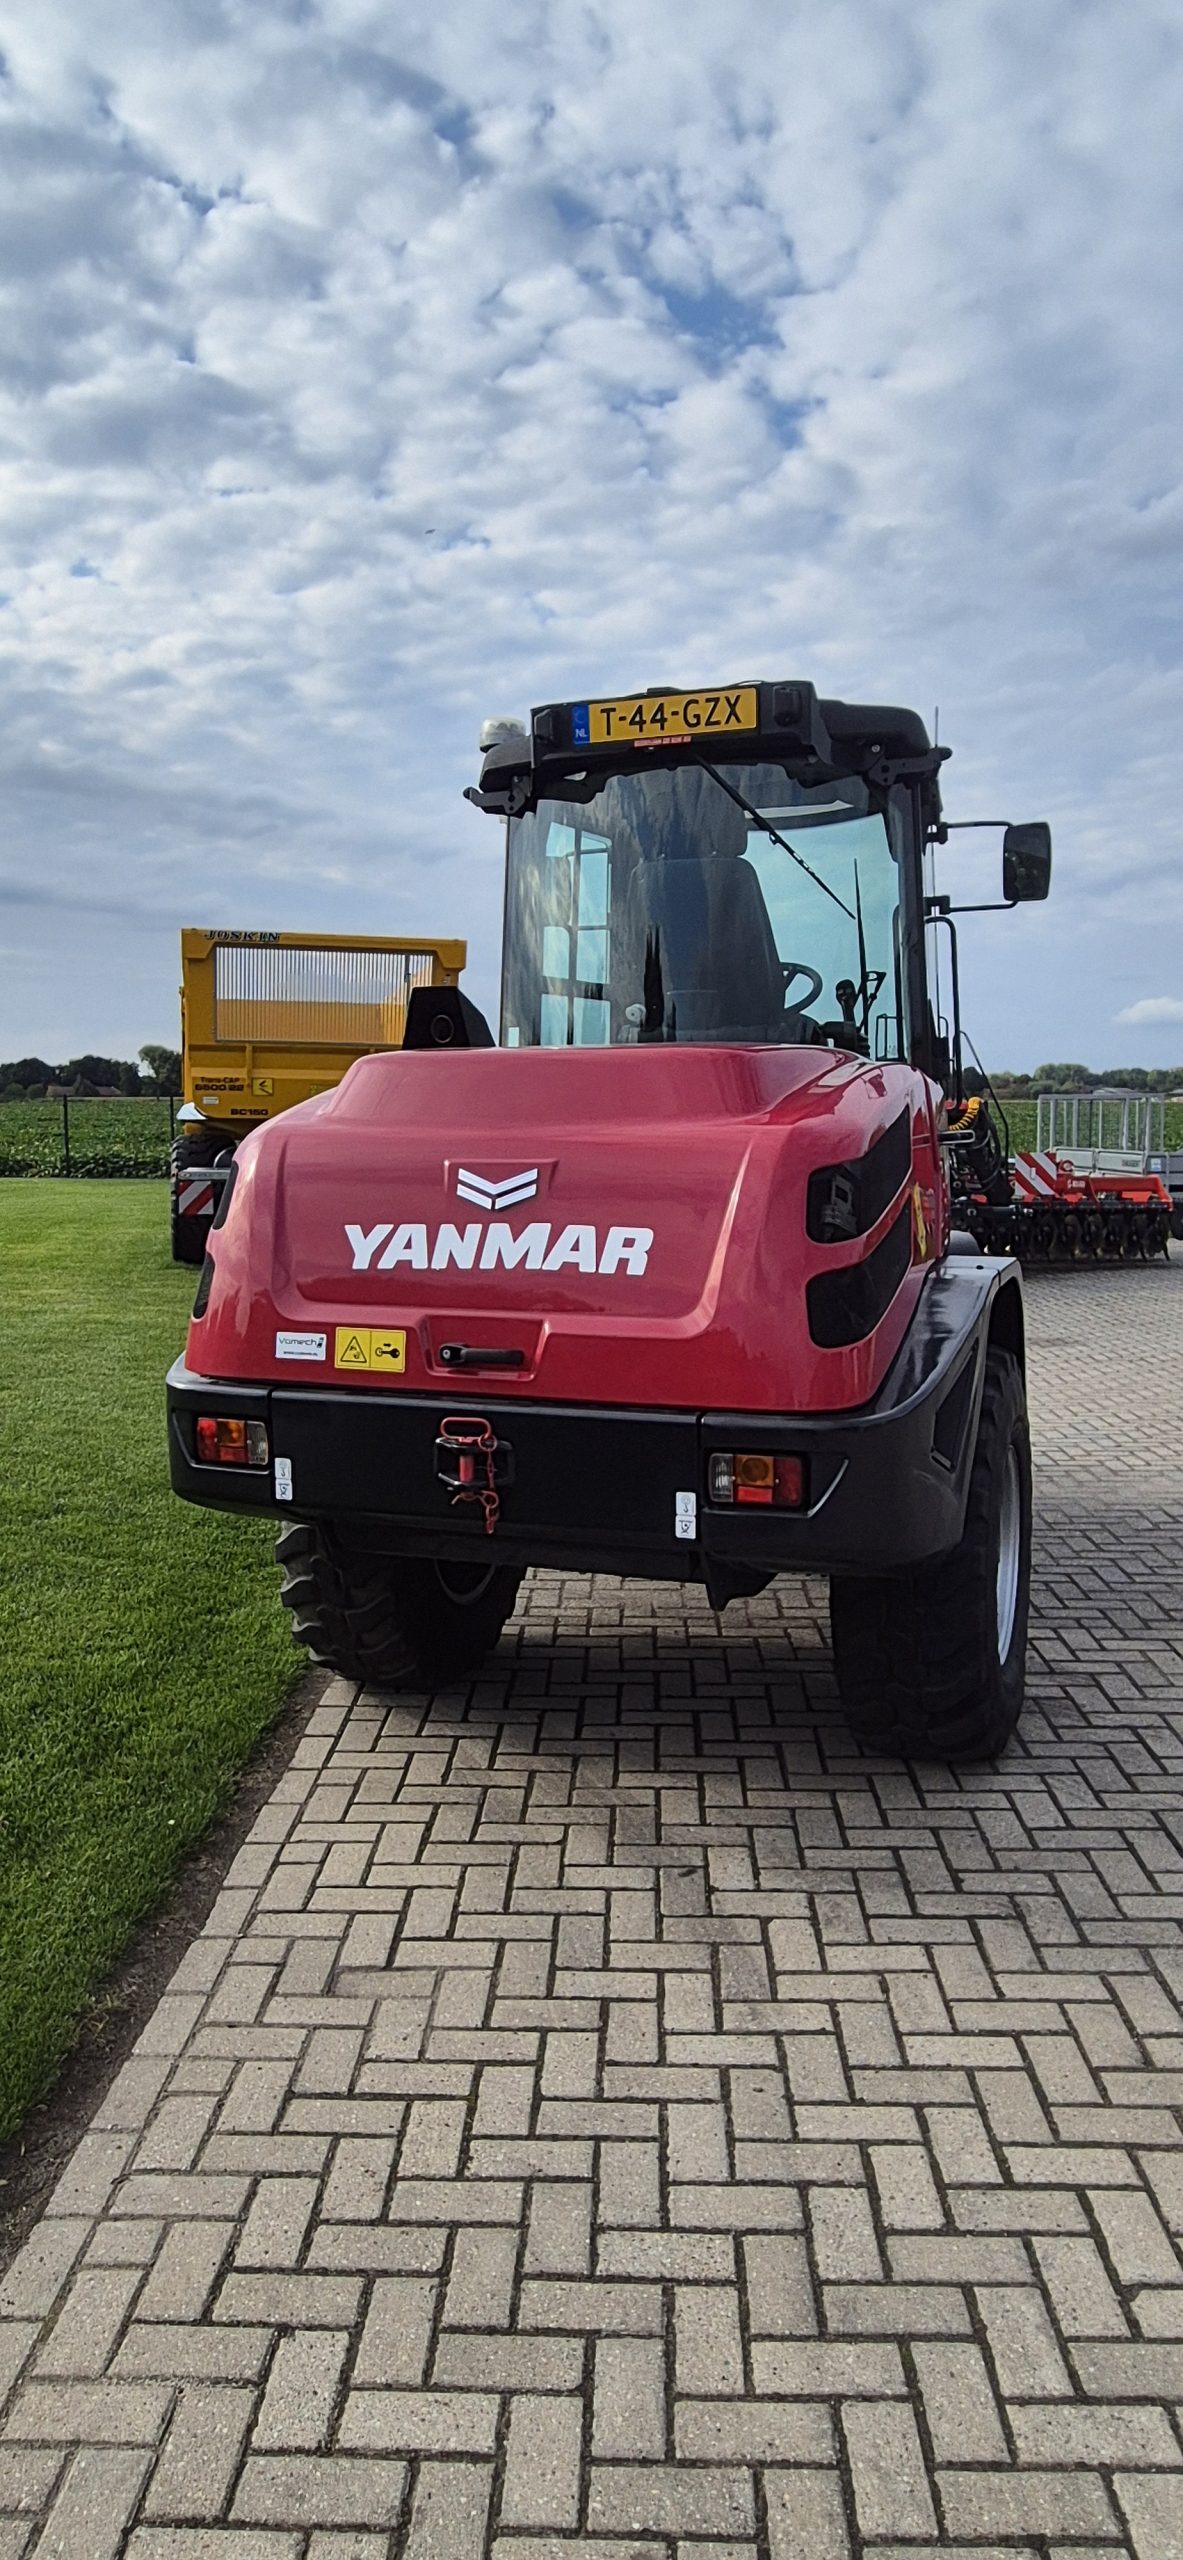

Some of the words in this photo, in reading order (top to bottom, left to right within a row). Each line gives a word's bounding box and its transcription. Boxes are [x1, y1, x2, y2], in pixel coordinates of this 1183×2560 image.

[600, 695, 742, 736] T-44-GZX
[575, 729, 588, 738] NL
[204, 930, 281, 941] JOSKIN
[344, 1223, 654, 1276] YANMAR
